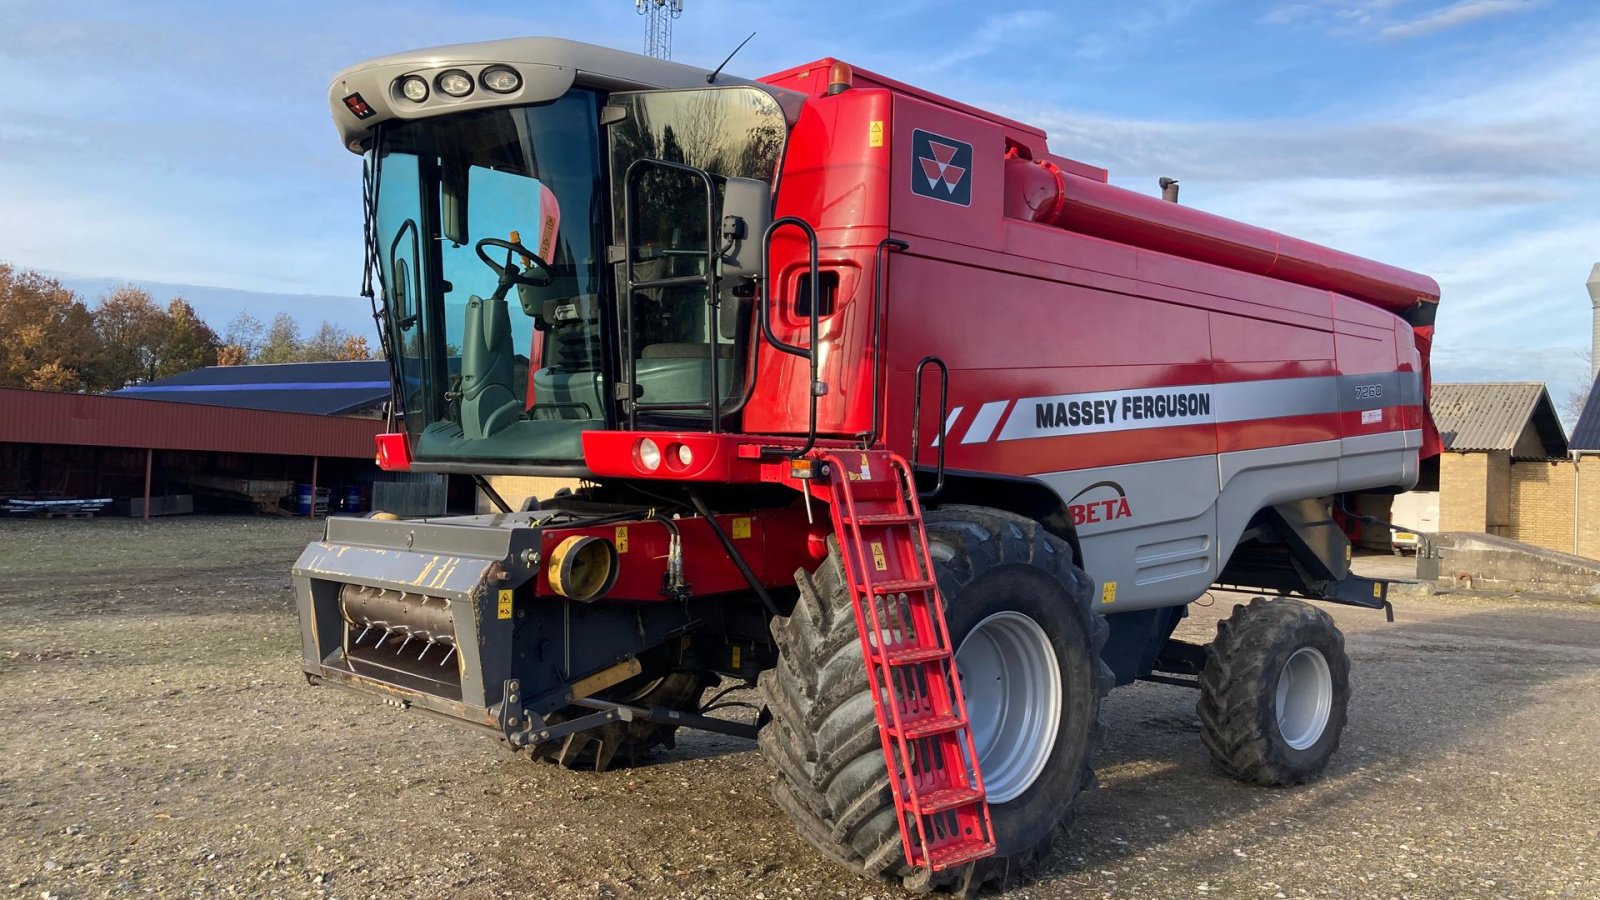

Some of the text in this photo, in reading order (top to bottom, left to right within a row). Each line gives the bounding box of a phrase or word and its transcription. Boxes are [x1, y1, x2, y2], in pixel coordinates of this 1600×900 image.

[1355, 384, 1383, 399] 7260
[1035, 392, 1210, 429] MASSEY FERGUSON
[1068, 497, 1132, 526] BETA
